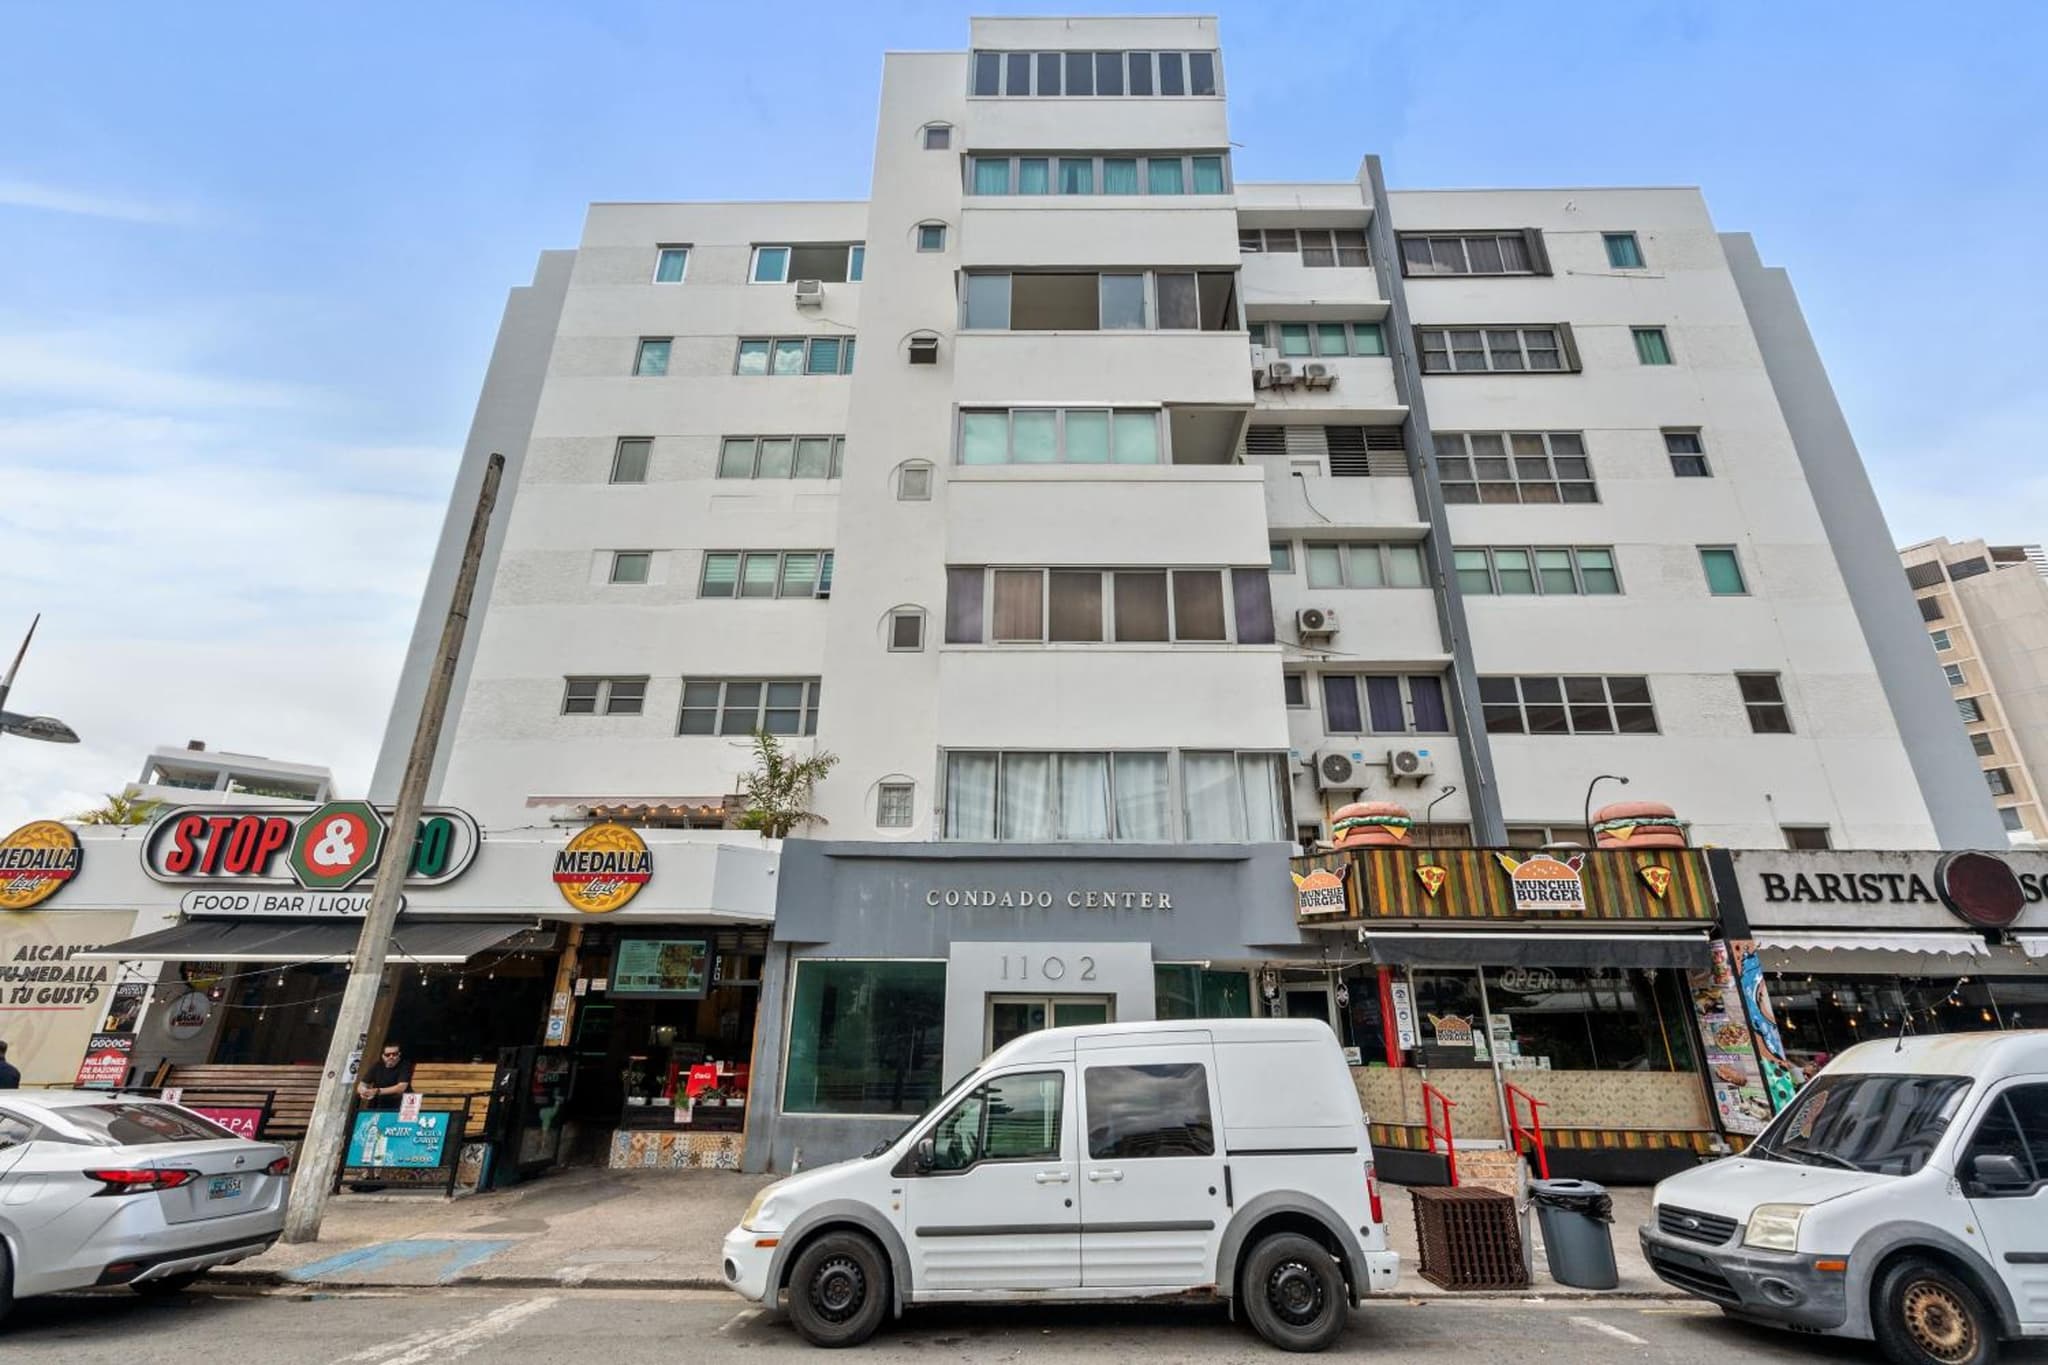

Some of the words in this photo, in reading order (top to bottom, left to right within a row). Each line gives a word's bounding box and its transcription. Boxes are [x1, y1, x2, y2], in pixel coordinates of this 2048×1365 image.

[165, 815, 289, 874] STOP
[313, 818, 355, 867] &
[406, 817, 452, 877] O
[555, 850, 652, 873] MEDALLA
[1301, 887, 1344, 898] MUNCHIE
[1515, 880, 1580, 890] MUNCHIE
[1759, 872, 1938, 903] BARISTA
[192, 895, 249, 912] FOOD
[263, 896, 303, 912] BAR
[317, 897, 372, 915] LIQU
[926, 890, 1053, 908] CONDADO
[1067, 892, 1173, 910] CENTER
[1301, 895, 1343, 907] BURGER
[1516, 890, 1582, 901] BURGER
[19, 966, 107, 982] MEDALLA
[1000, 956, 1097, 981] 1102
[1503, 969, 1550, 990] OPEN
[10, 987, 34, 1004] TU
[37, 987, 99, 1004] GUSTO
